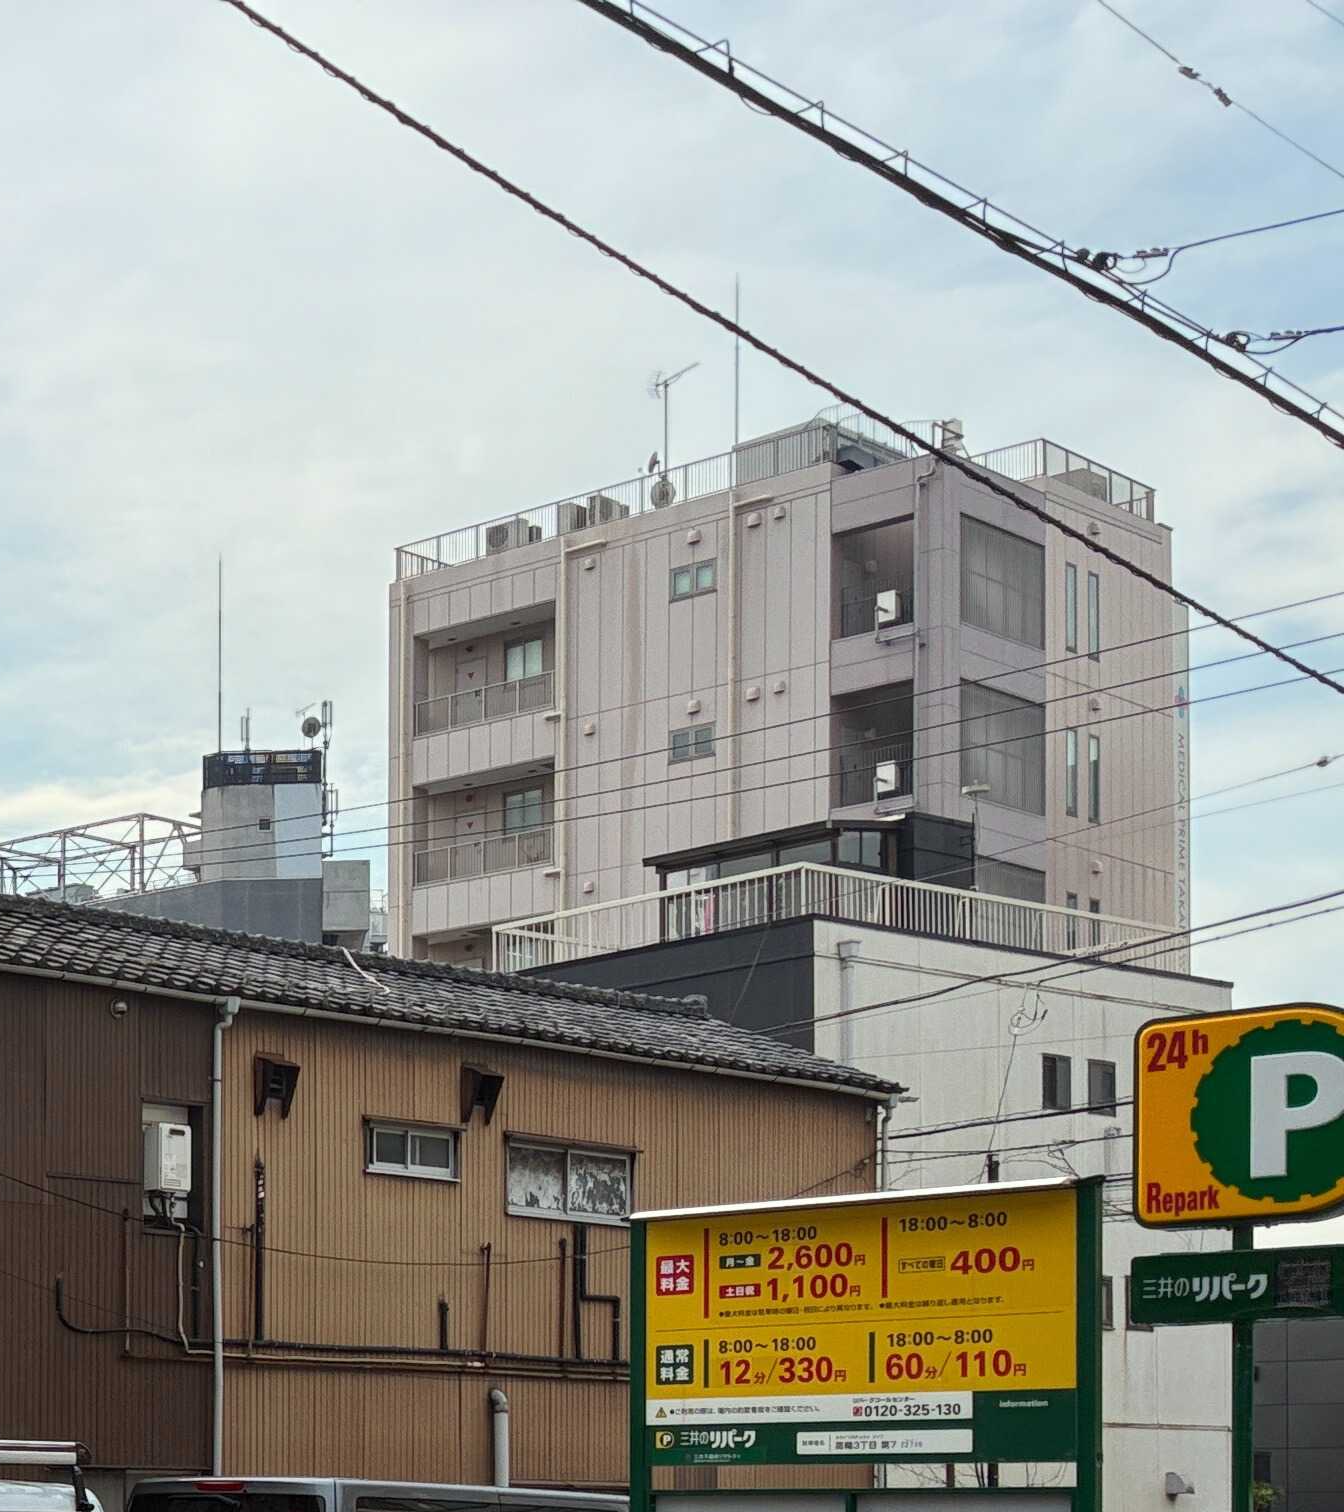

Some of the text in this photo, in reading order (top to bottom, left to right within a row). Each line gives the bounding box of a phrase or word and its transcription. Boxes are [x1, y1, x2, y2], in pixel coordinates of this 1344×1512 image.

[1250, 1051, 1344, 1179] P
[1146, 1182, 1220, 1217] Repark
[768, 1242, 866, 1271] 2,600円
[950, 1247, 1035, 1275] 400円
[660, 1276, 690, 1292] 料金
[767, 1273, 861, 1302] 1,100円
[1142, 1272, 1268, 1302] 三井のリパーク
[660, 1349, 689, 1364] 通常
[660, 1366, 689, 1382] 料金
[864, 1403, 961, 1417] 0120-325-130
[680, 1428, 756, 1448] 三井のリパーク
